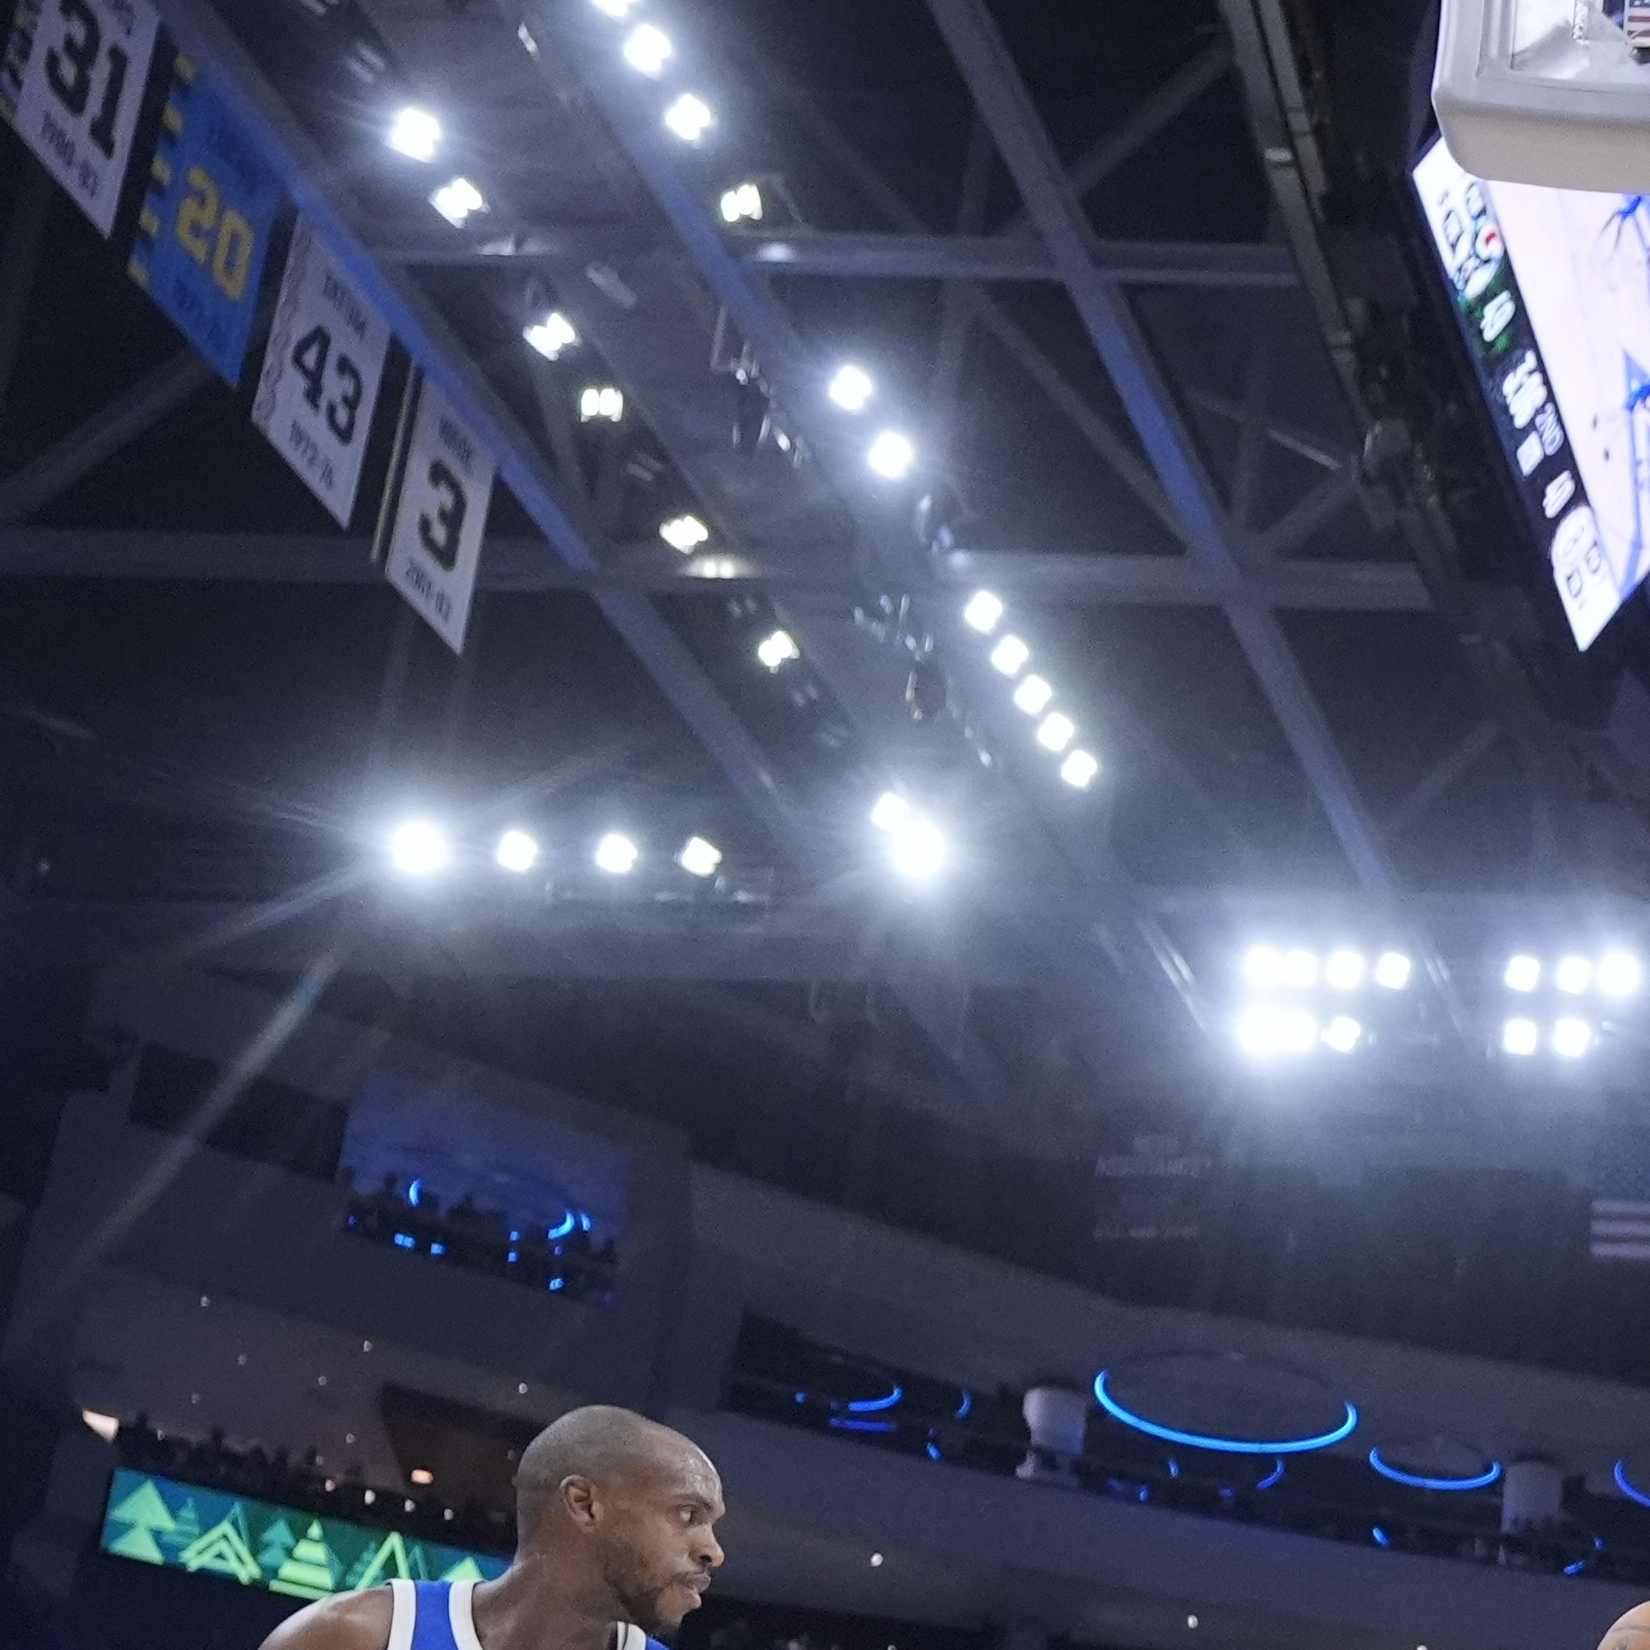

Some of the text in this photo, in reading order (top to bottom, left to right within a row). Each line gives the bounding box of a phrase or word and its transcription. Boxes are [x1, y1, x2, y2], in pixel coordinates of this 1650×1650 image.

[45, 0, 131, 160] 31
[176, 166, 254, 300] 20
[291, 325, 363, 446] 43
[418, 459, 467, 572] 3
